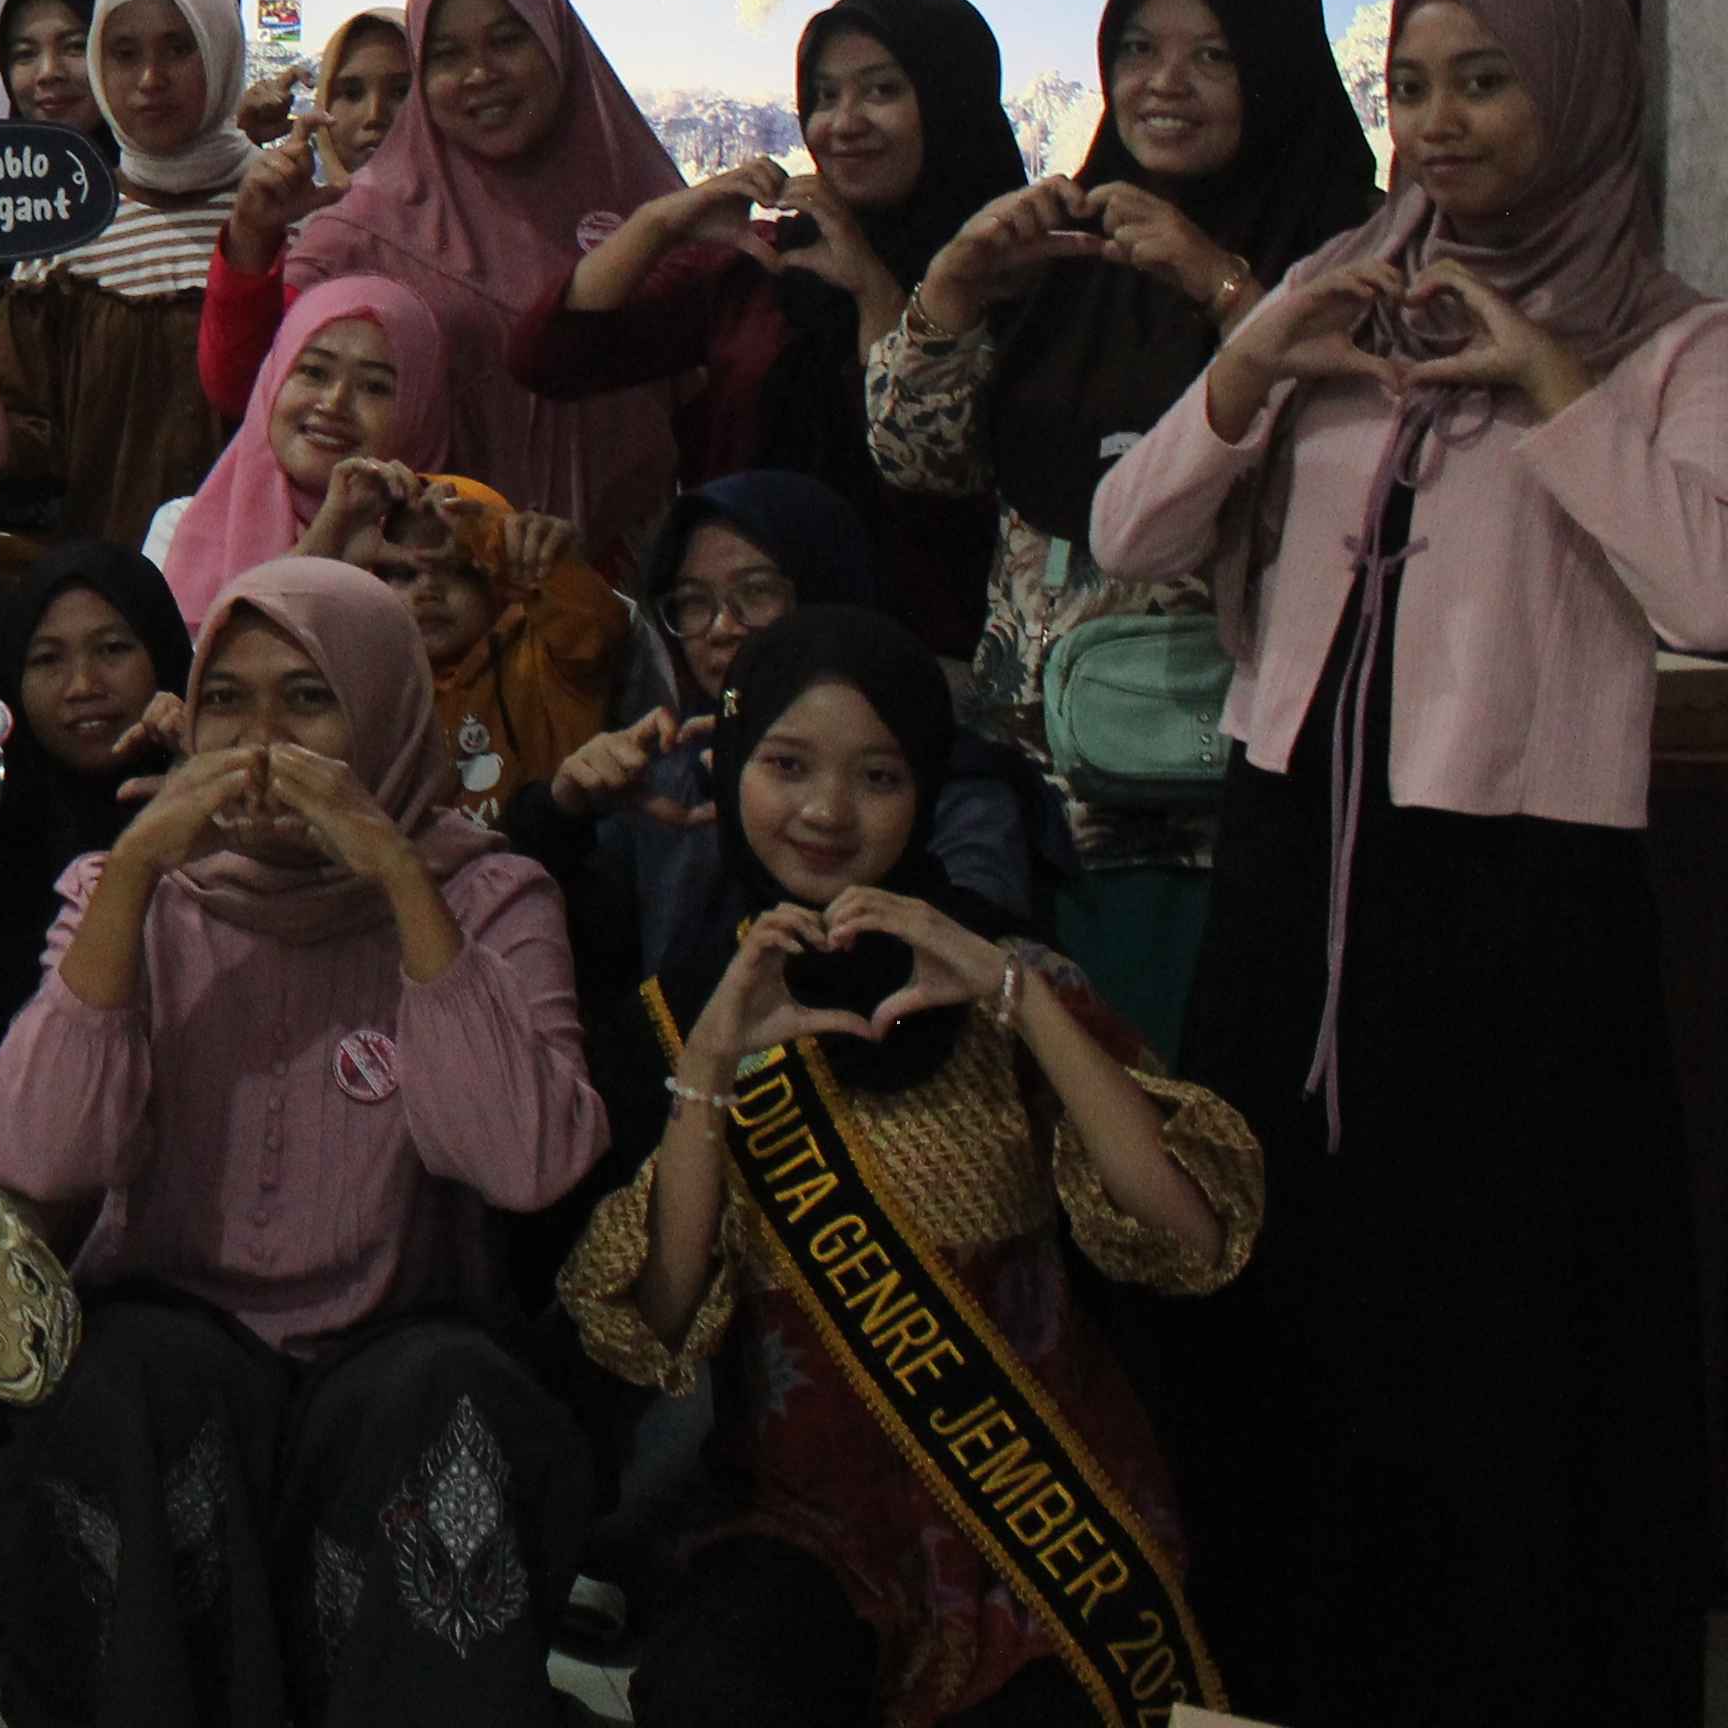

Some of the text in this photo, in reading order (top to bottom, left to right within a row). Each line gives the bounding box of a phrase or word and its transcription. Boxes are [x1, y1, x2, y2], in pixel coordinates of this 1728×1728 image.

[728, 1071, 840, 1224] DUTA
[808, 1213, 968, 1398] GENRE
[929, 1395, 1130, 1621] JEMBER
